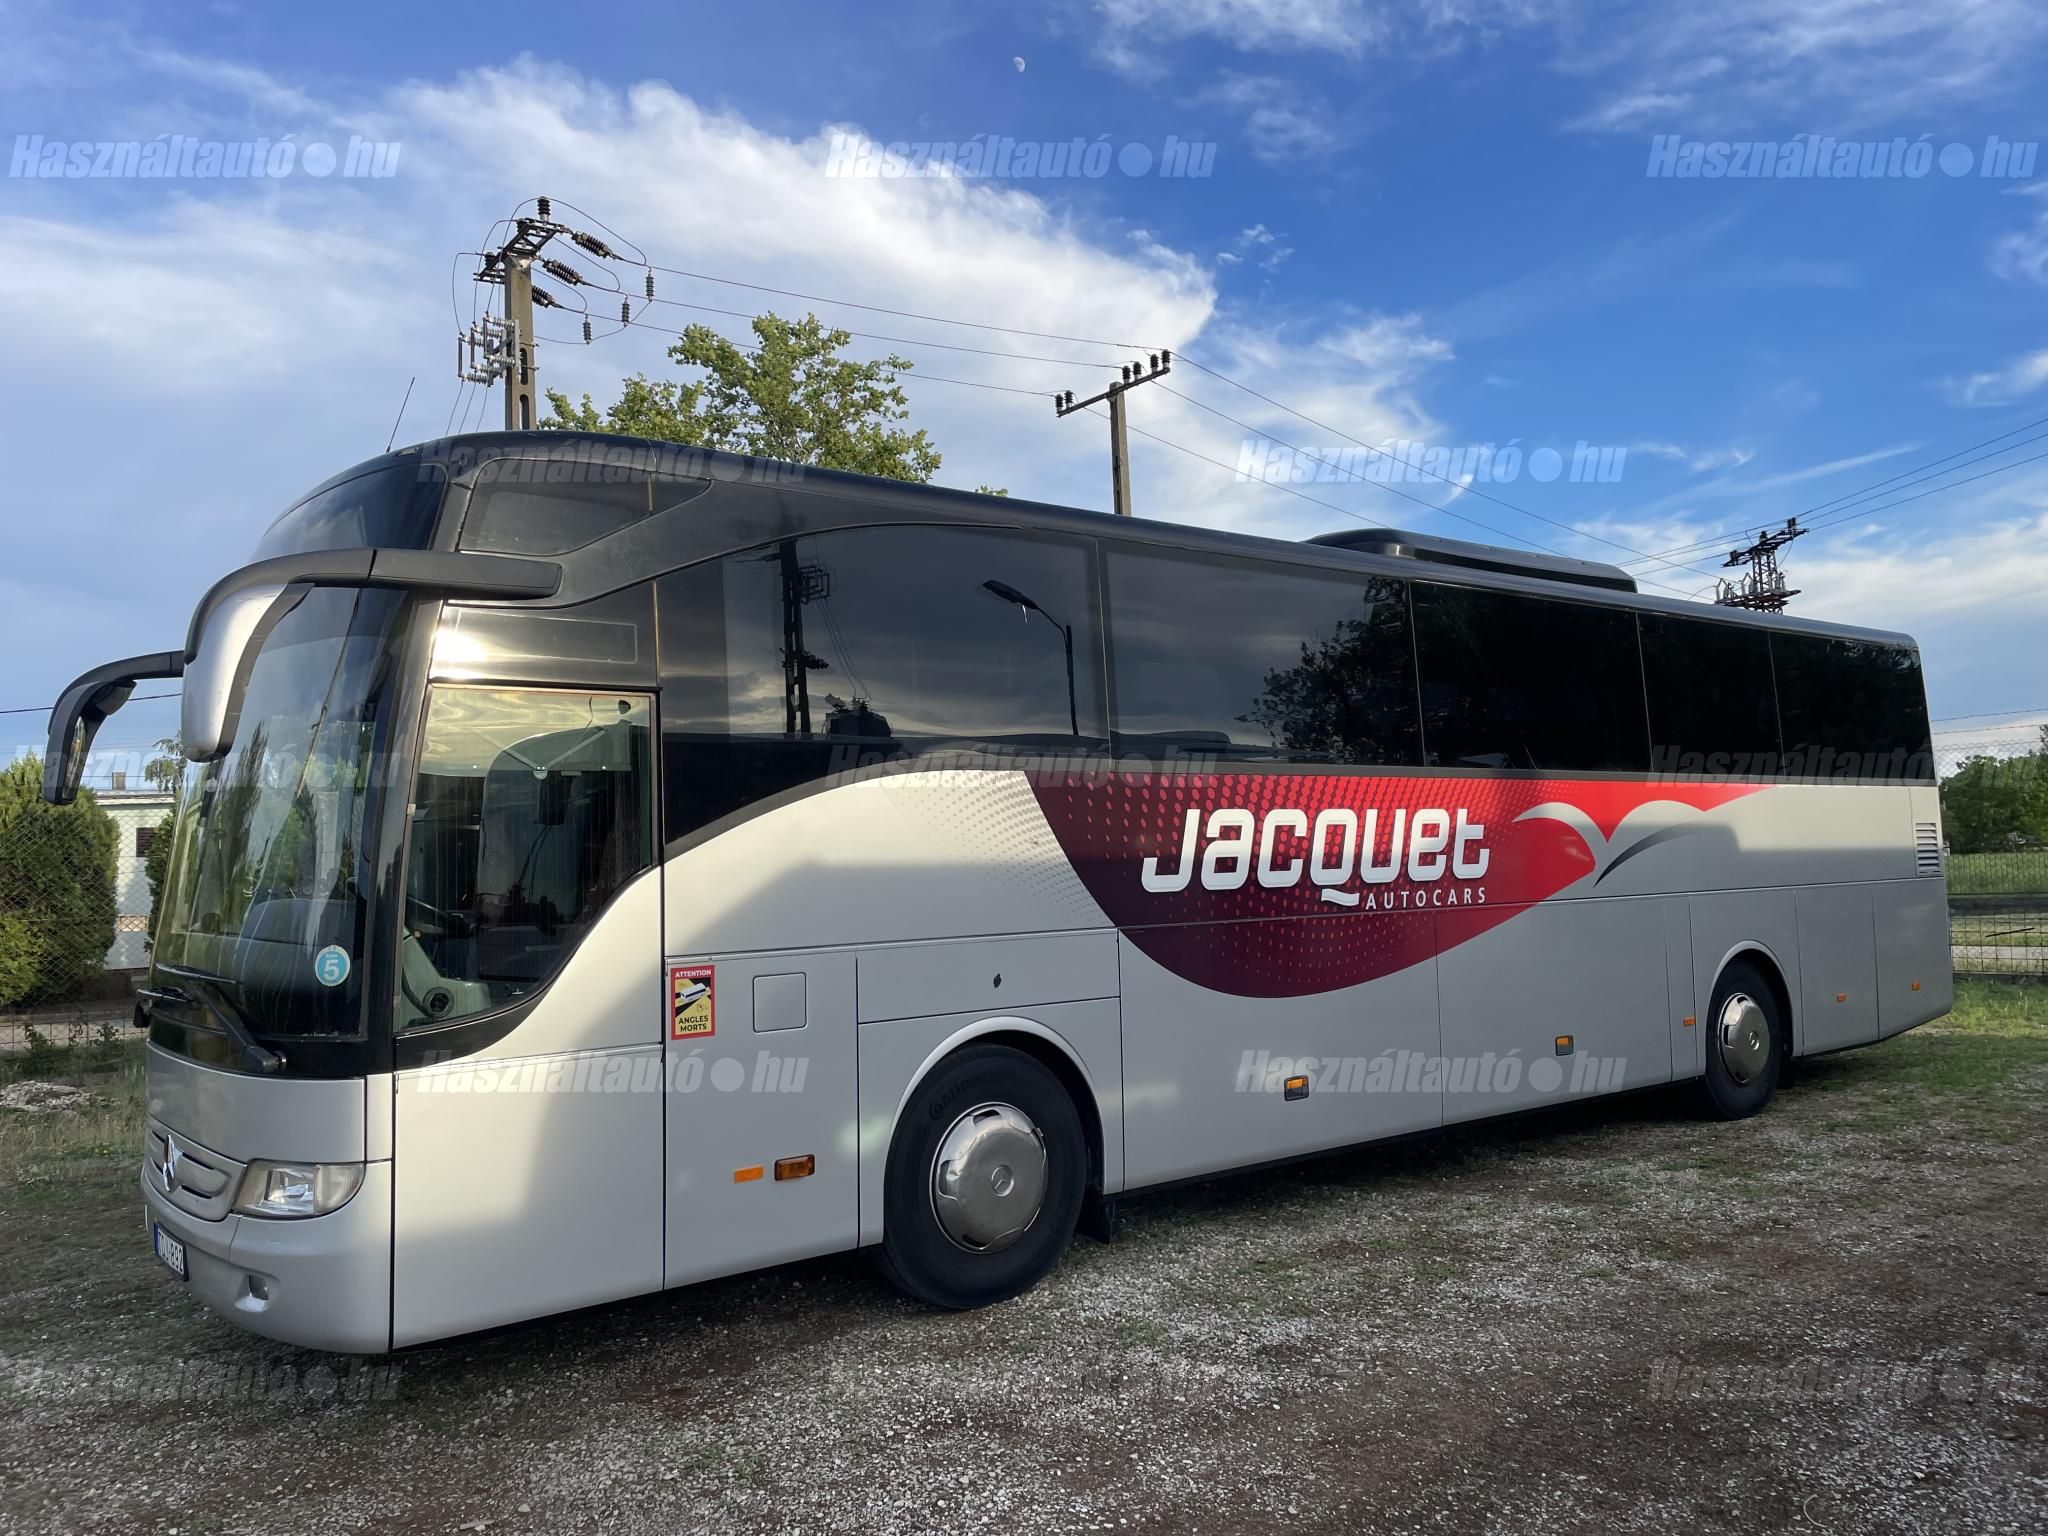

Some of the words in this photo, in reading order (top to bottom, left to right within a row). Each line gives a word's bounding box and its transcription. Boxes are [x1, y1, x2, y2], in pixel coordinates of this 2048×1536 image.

[1366, 887, 1487, 910] AUTOCARS
[324, 960, 340, 980] 5
[675, 969, 712, 978] ATTENTION
[678, 1015, 709, 1024] ANGLES
[680, 1023, 707, 1033] MORTS
